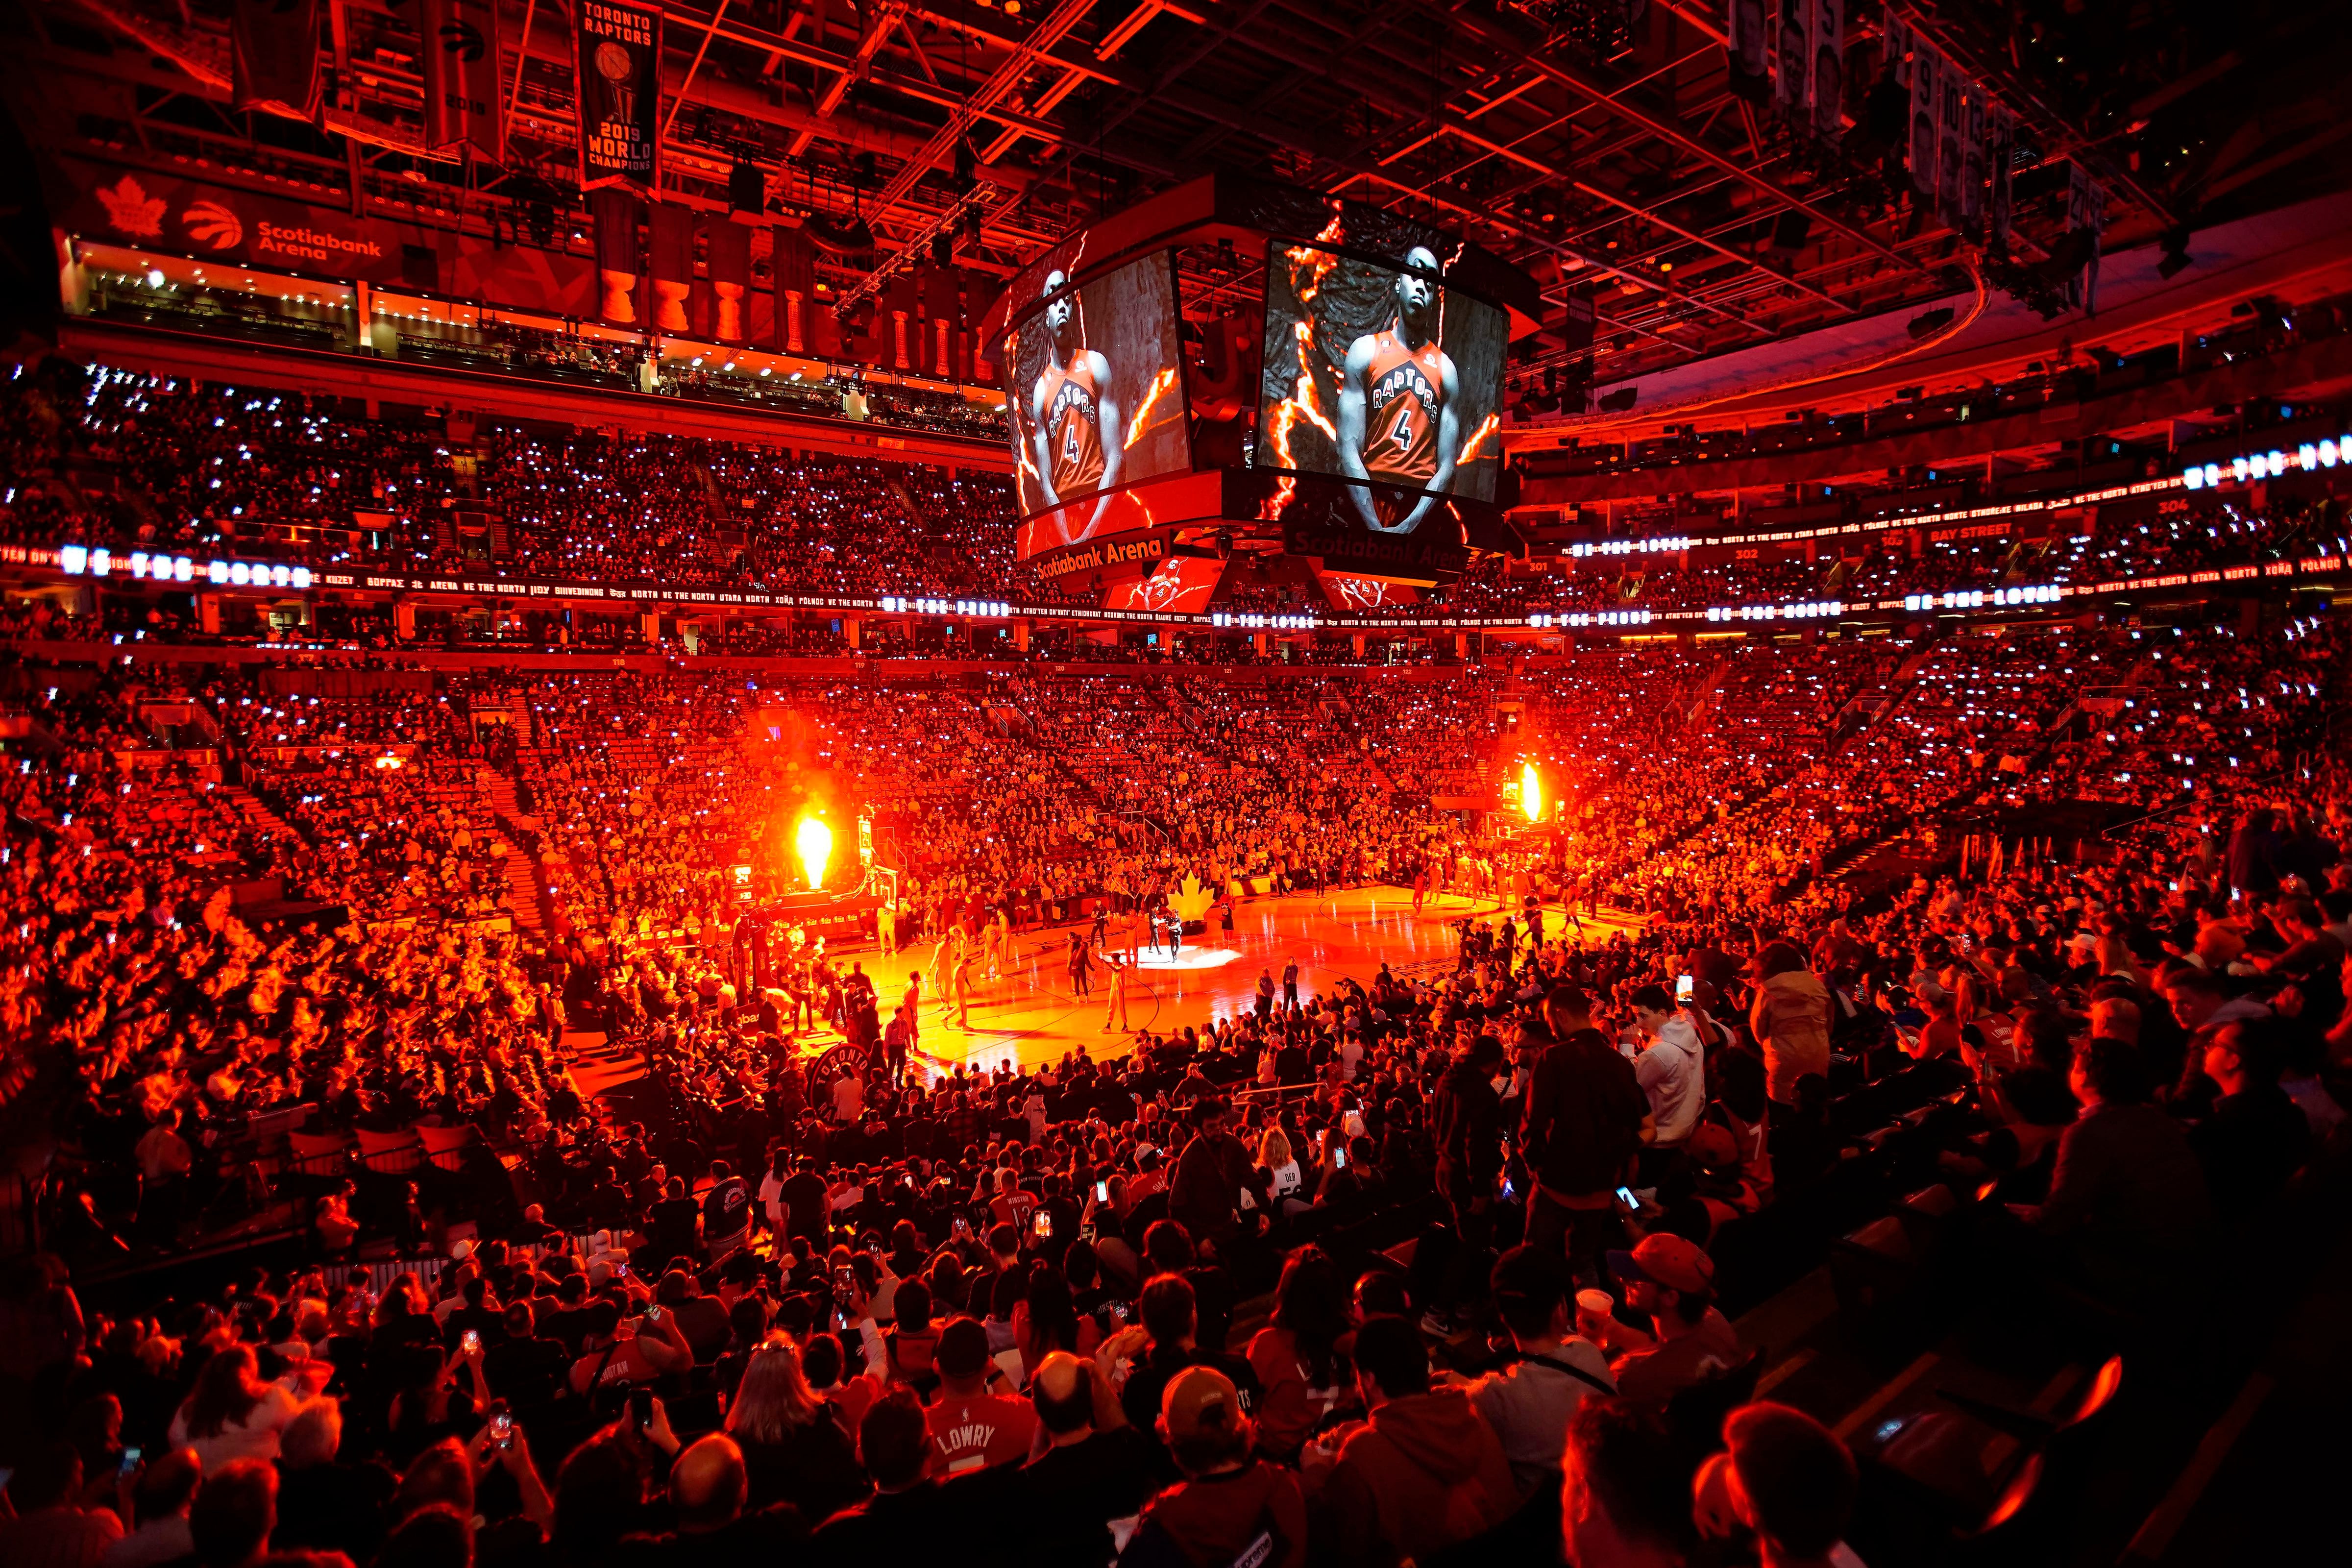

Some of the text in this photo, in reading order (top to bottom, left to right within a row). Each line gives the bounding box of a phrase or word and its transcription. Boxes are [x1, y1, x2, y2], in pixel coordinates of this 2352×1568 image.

[585, 1, 649, 30] TORONTO
[585, 17, 651, 46] RAPTORS
[1920, 59, 1931, 106] 9
[1944, 81, 1959, 131] 10
[601, 122, 640, 142] 2019
[588, 134, 650, 159] WORLD
[588, 153, 650, 170] CHAMPIONS
[258, 221, 381, 257] Scotiabank
[259, 237, 327, 260] Arena
[1373, 368, 1438, 424] RAPTORS
[1049, 385, 1095, 439] RAPTORS
[1391, 409, 1412, 451] 4
[1064, 424, 1078, 464] 4
[1917, 514, 1941, 524] NORTH
[2159, 499, 2190, 514] 304
[1931, 523, 2012, 541] BAY STREET
[1037, 539, 1162, 580] Scotiabank Arena
[1294, 531, 1414, 564] Scotiabank
[1736, 548, 1758, 559] 302
[1529, 563, 1547, 571] 301
[2097, 582, 2126, 592] NORTH
[2141, 578, 2157, 589] THE
[2158, 575, 2188, 587] NORTH
[2223, 566, 2258, 581] NORTH
[478, 583, 494, 592] THE
[497, 585, 526, 593] NORTH
[632, 590, 658, 598] NORTH
[691, 592, 715, 601] NORTH
[746, 595, 769, 603] NORTH
[1991, 1027, 2011, 1038] LOWRY
[816, 1049, 868, 1085] TORONTO
[1748, 1124, 1762, 1160] 7
[1007, 1195, 1029, 1205] WINSTON
[937, 1424, 996, 1455] LOWRY
